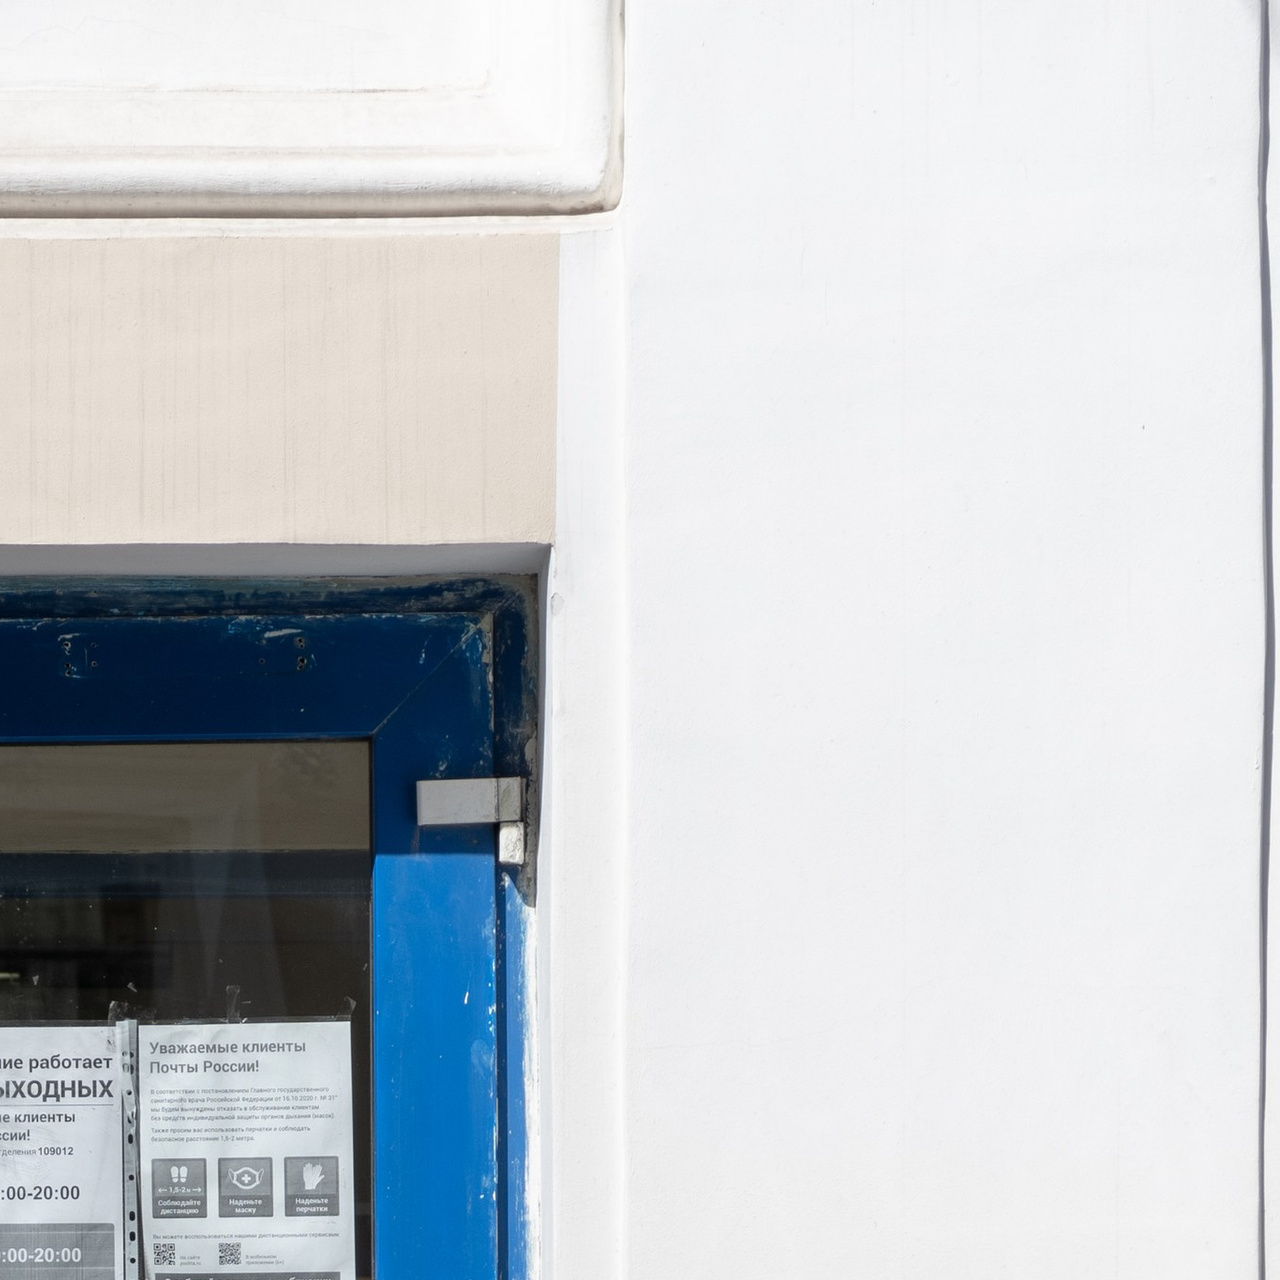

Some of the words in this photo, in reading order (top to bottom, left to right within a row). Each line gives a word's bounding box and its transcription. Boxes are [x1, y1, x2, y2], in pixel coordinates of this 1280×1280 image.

[149, 1042, 238, 1054] Уважаемые
[242, 1042, 306, 1053] клиенты
[29, 1054, 113, 1072] работает
[150, 1061, 198, 1074] Почты
[203, 1060, 259, 1073] России!
[14, 1114, 75, 1123] клиенты
[38, 1147, 74, 1156] 109012
[158, 1199, 201, 1207] Соблюдайте
